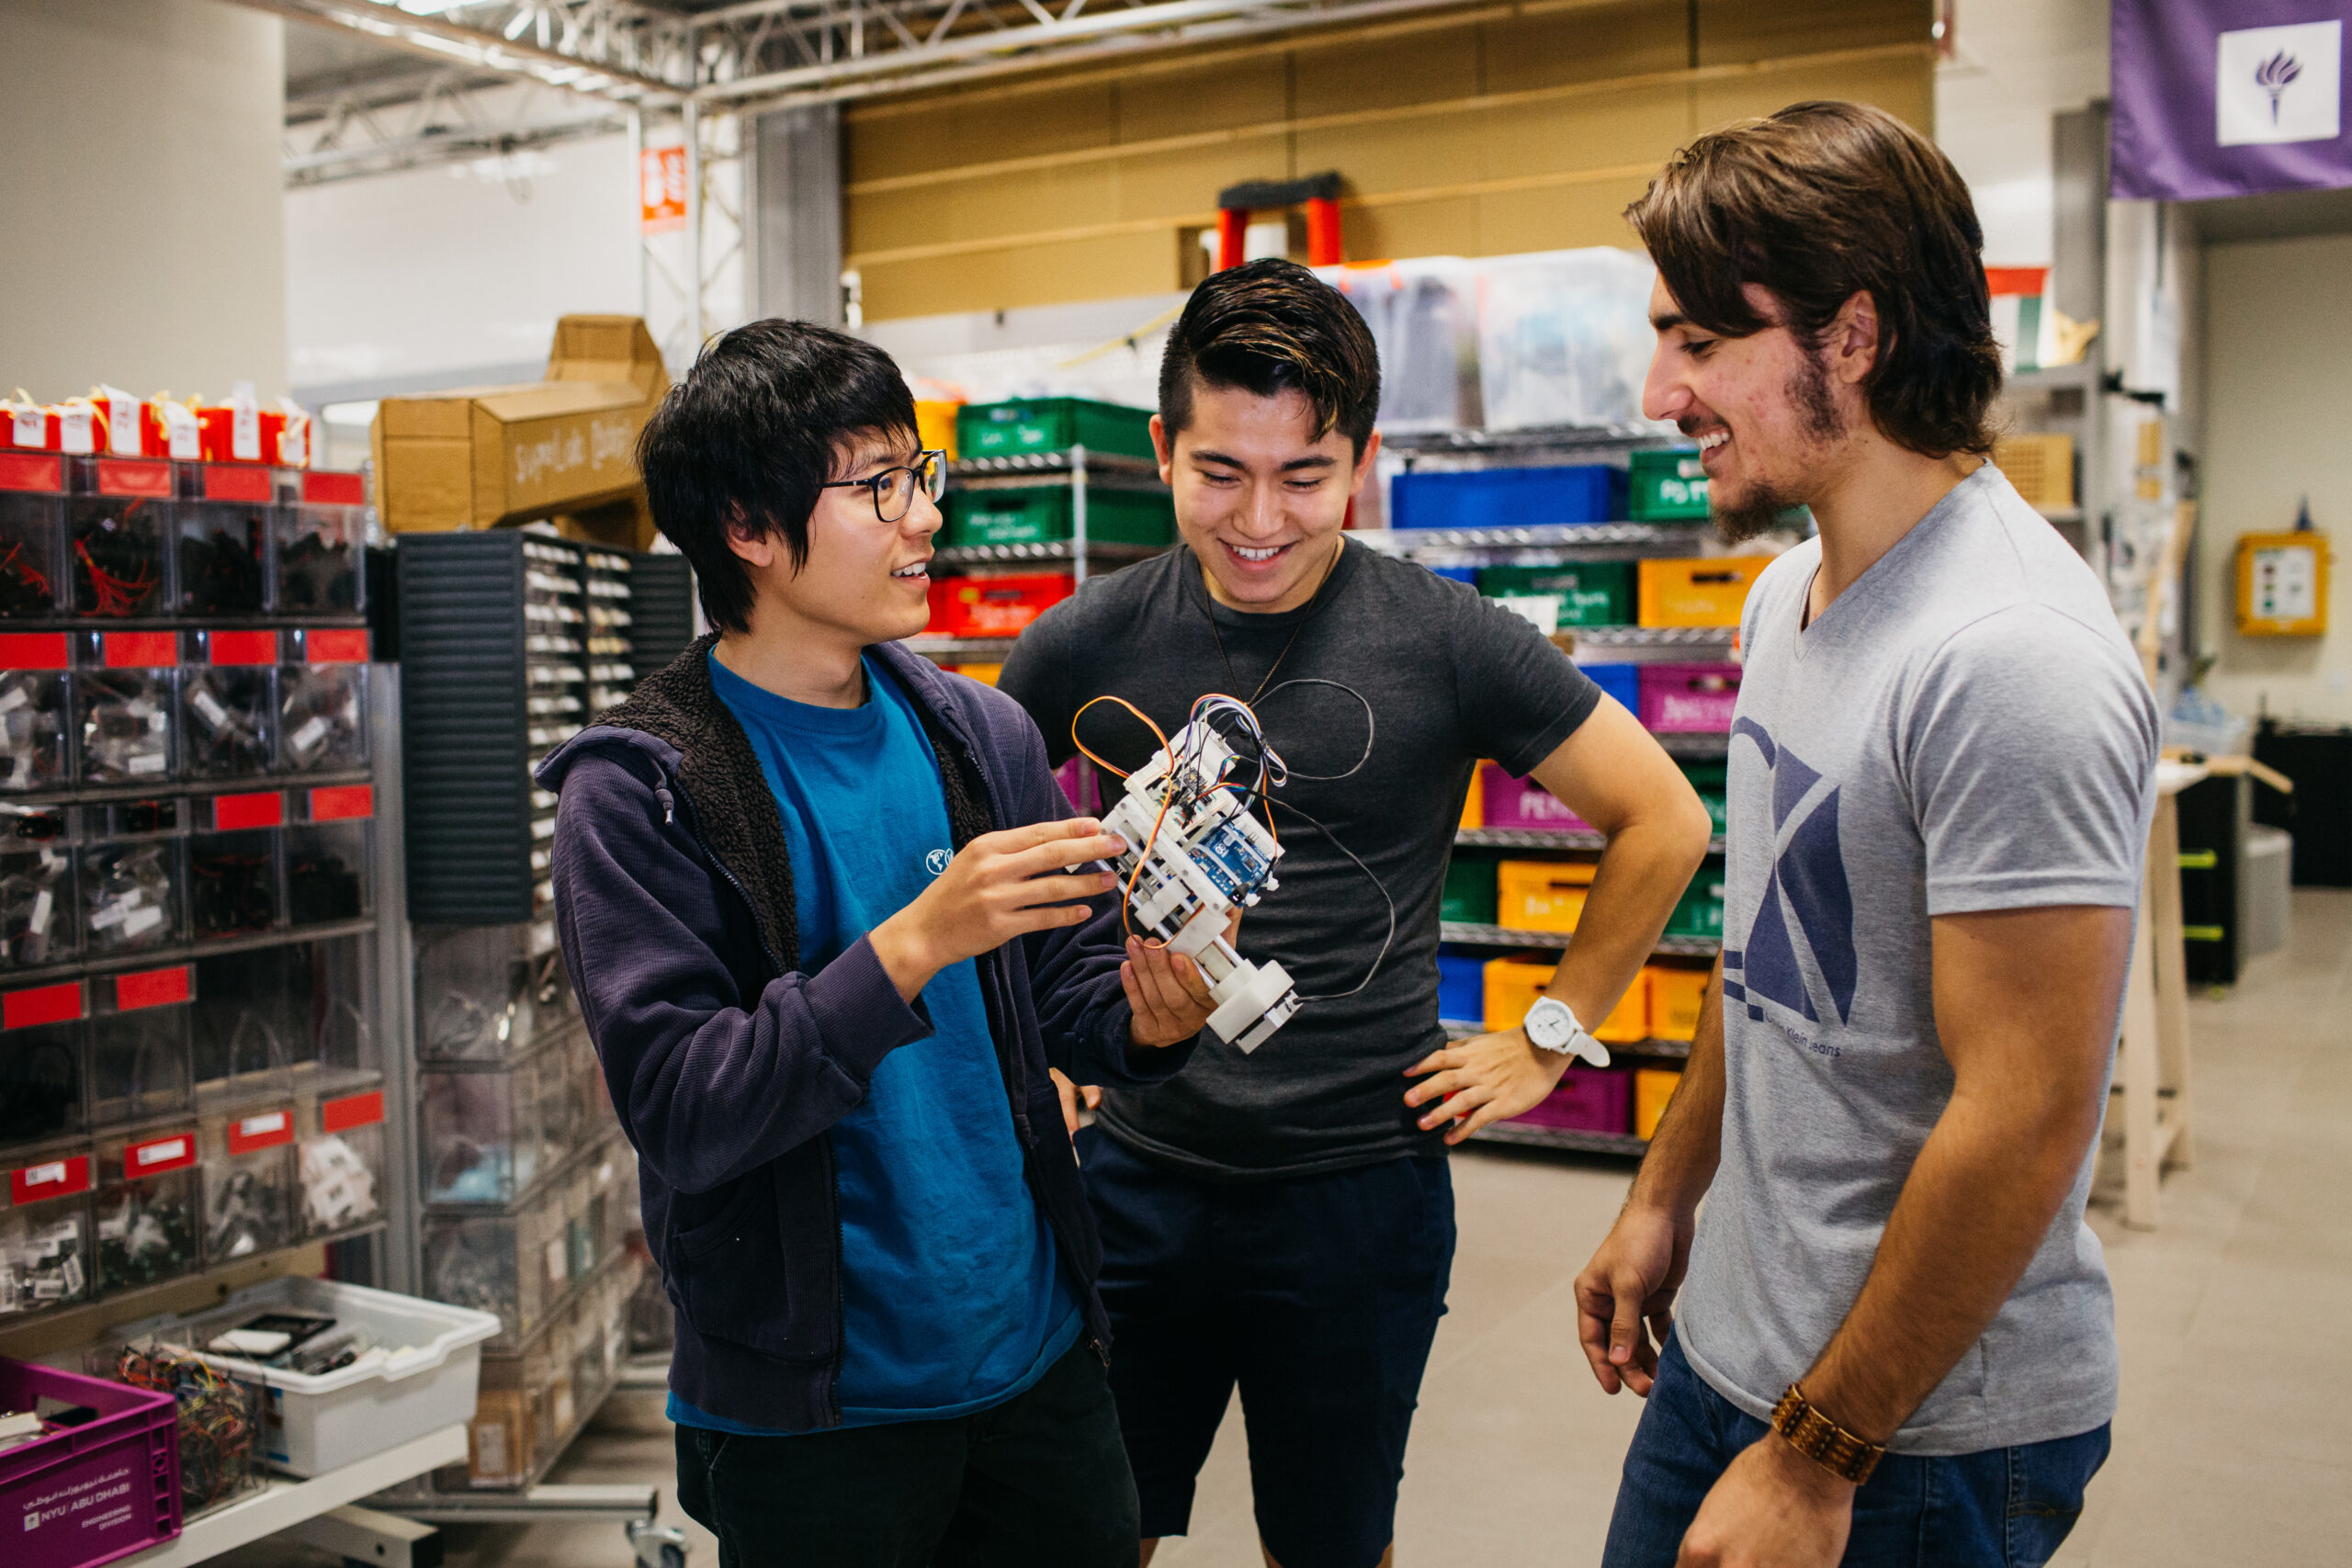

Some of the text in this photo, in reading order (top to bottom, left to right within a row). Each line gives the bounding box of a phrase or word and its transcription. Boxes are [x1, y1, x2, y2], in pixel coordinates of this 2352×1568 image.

[1808, 1041, 1842, 1058] eans
[41, 1483, 130, 1522] NYU ABU DHABI
[81, 1504, 131, 1529] ENGINEERING
[98, 1513, 131, 1530] DIVISION
